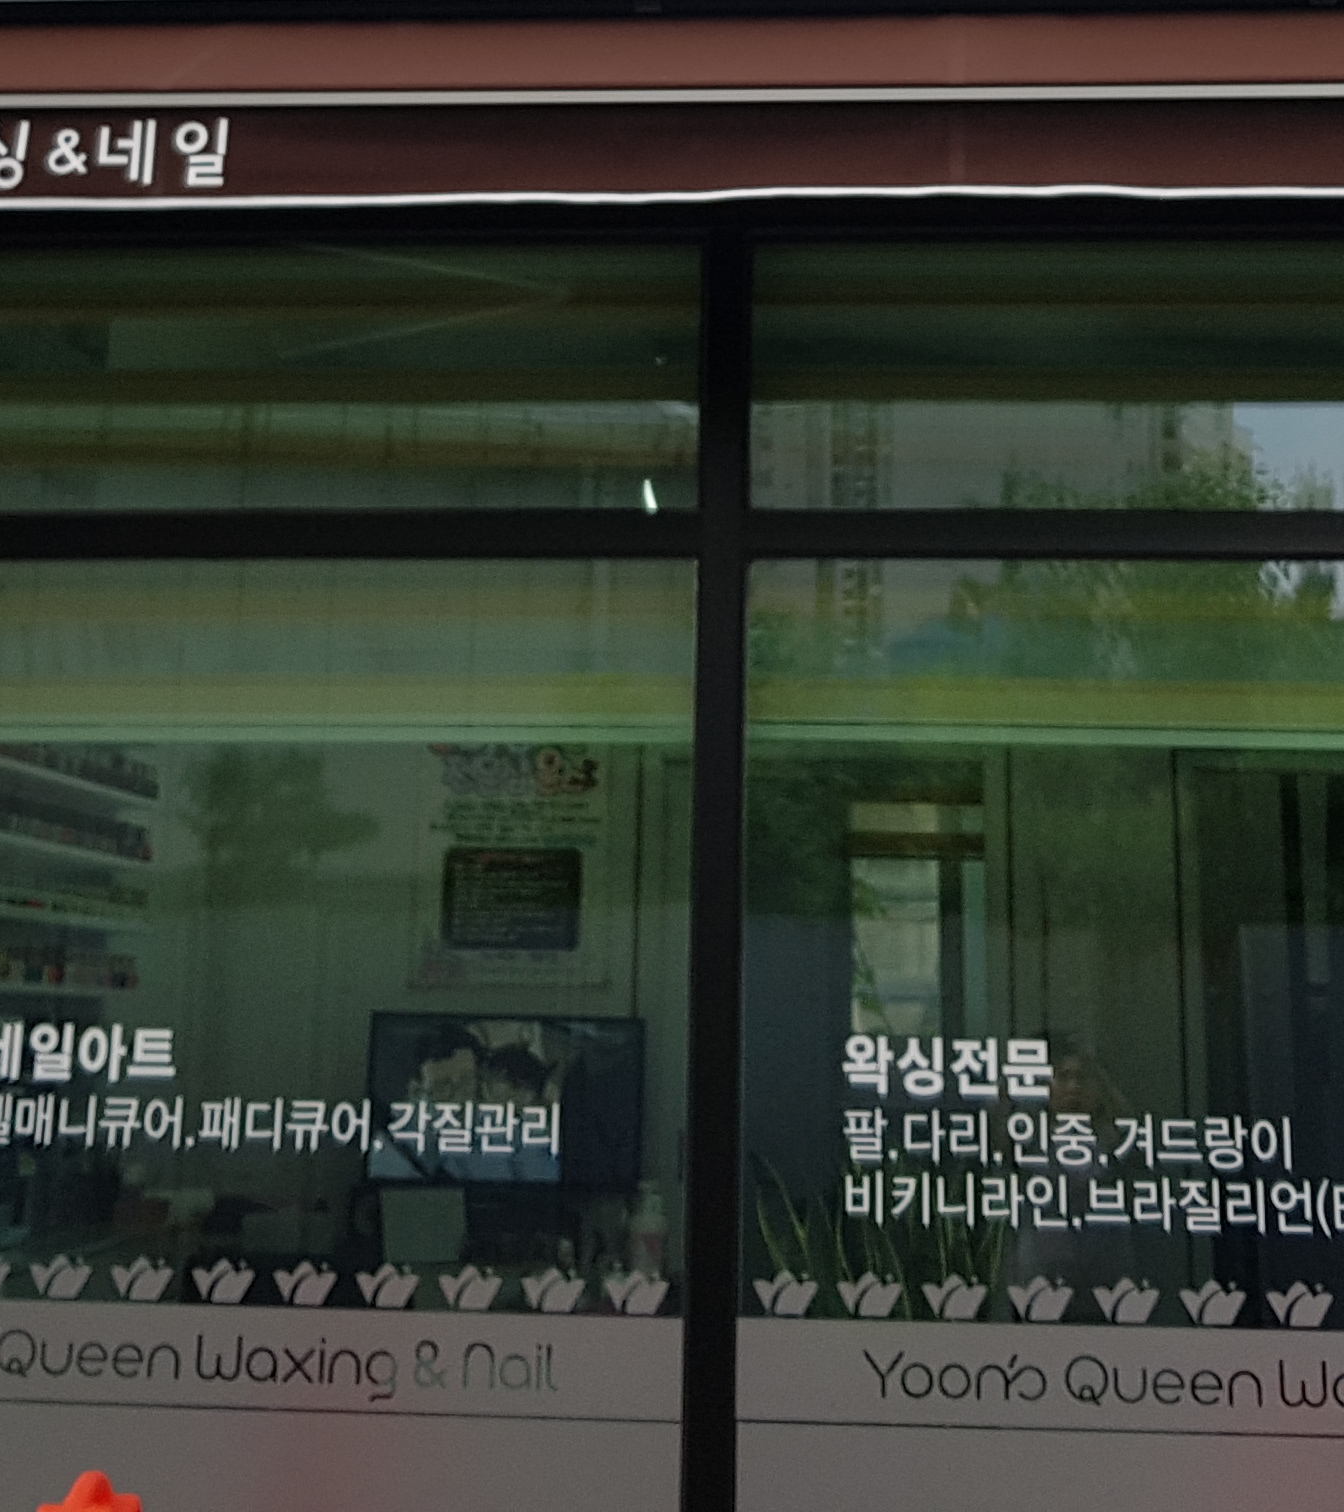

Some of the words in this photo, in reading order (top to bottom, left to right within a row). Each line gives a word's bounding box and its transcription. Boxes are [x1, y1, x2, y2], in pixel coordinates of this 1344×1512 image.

[842, 1034, 1054, 1097] 왁싱전문
[195, 1333, 397, 1403] Waxing
[413, 1340, 447, 1389] &
[462, 1342, 558, 1391] Nail
[1064, 1354, 1264, 1408] Queen
